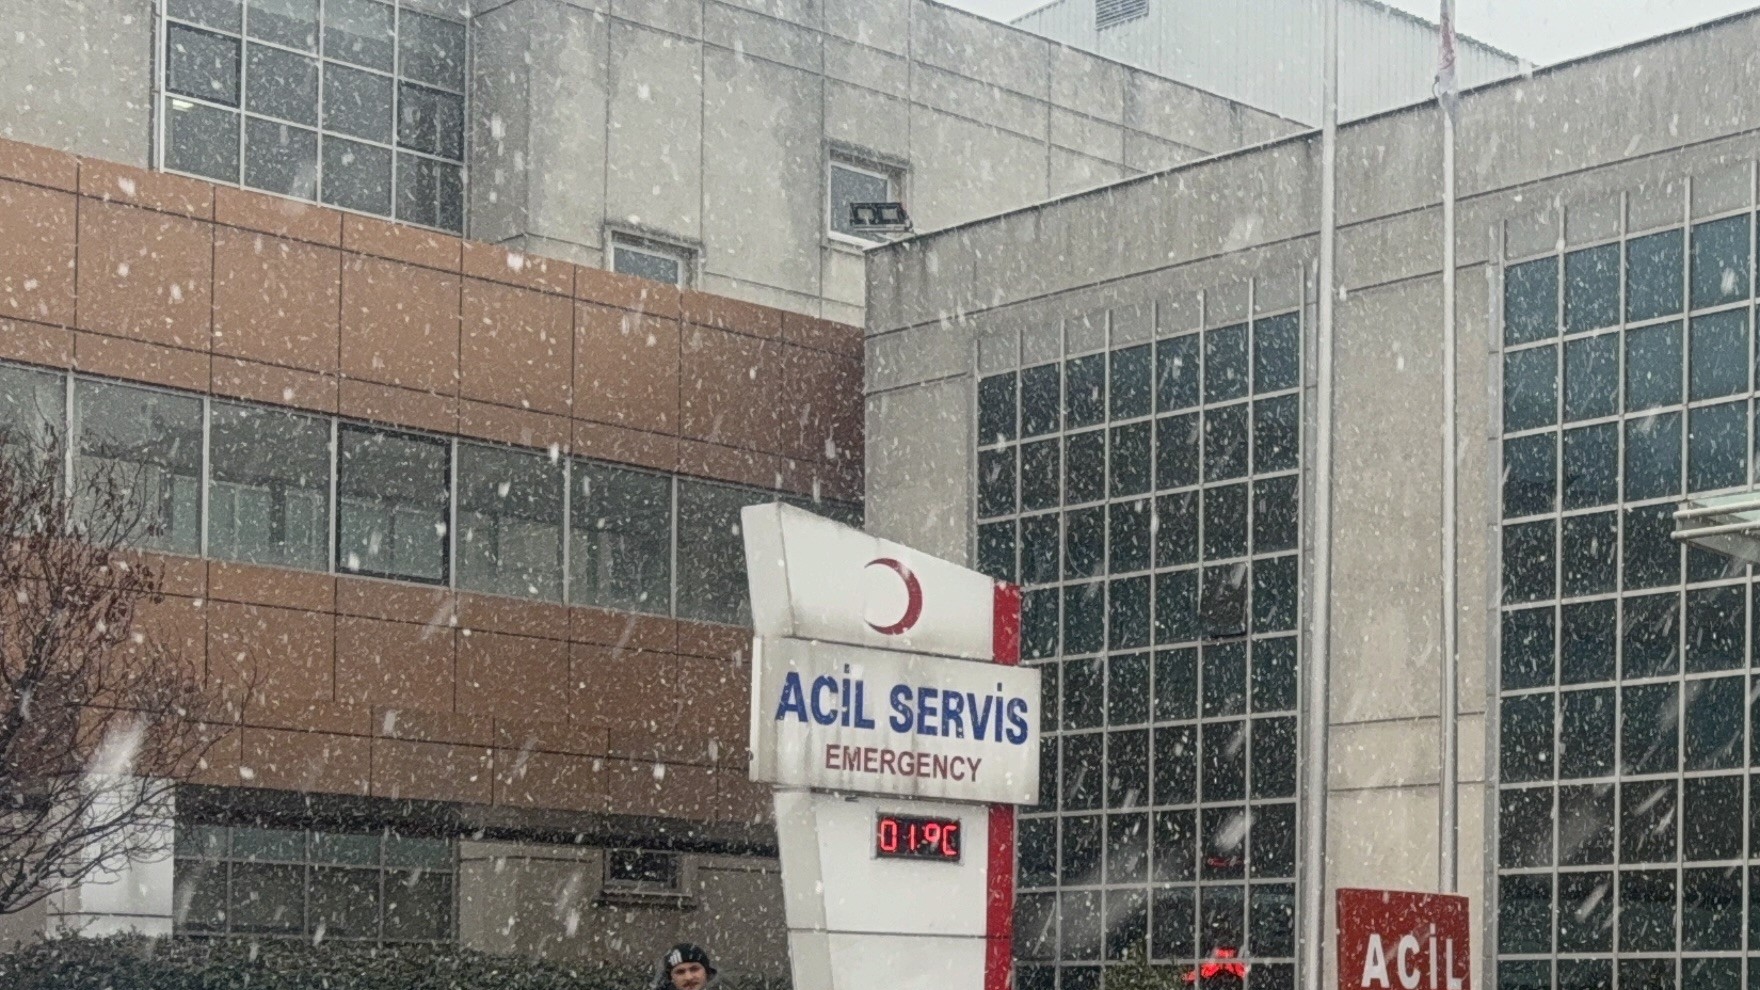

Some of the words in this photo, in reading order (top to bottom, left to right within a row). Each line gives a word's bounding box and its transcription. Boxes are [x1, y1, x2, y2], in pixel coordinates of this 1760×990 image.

[775, 664, 875, 730] ACİL
[889, 682, 1028, 745] SERVİS
[825, 743, 982, 782] EMERGENCY
[1361, 923, 1463, 990] ACİL
